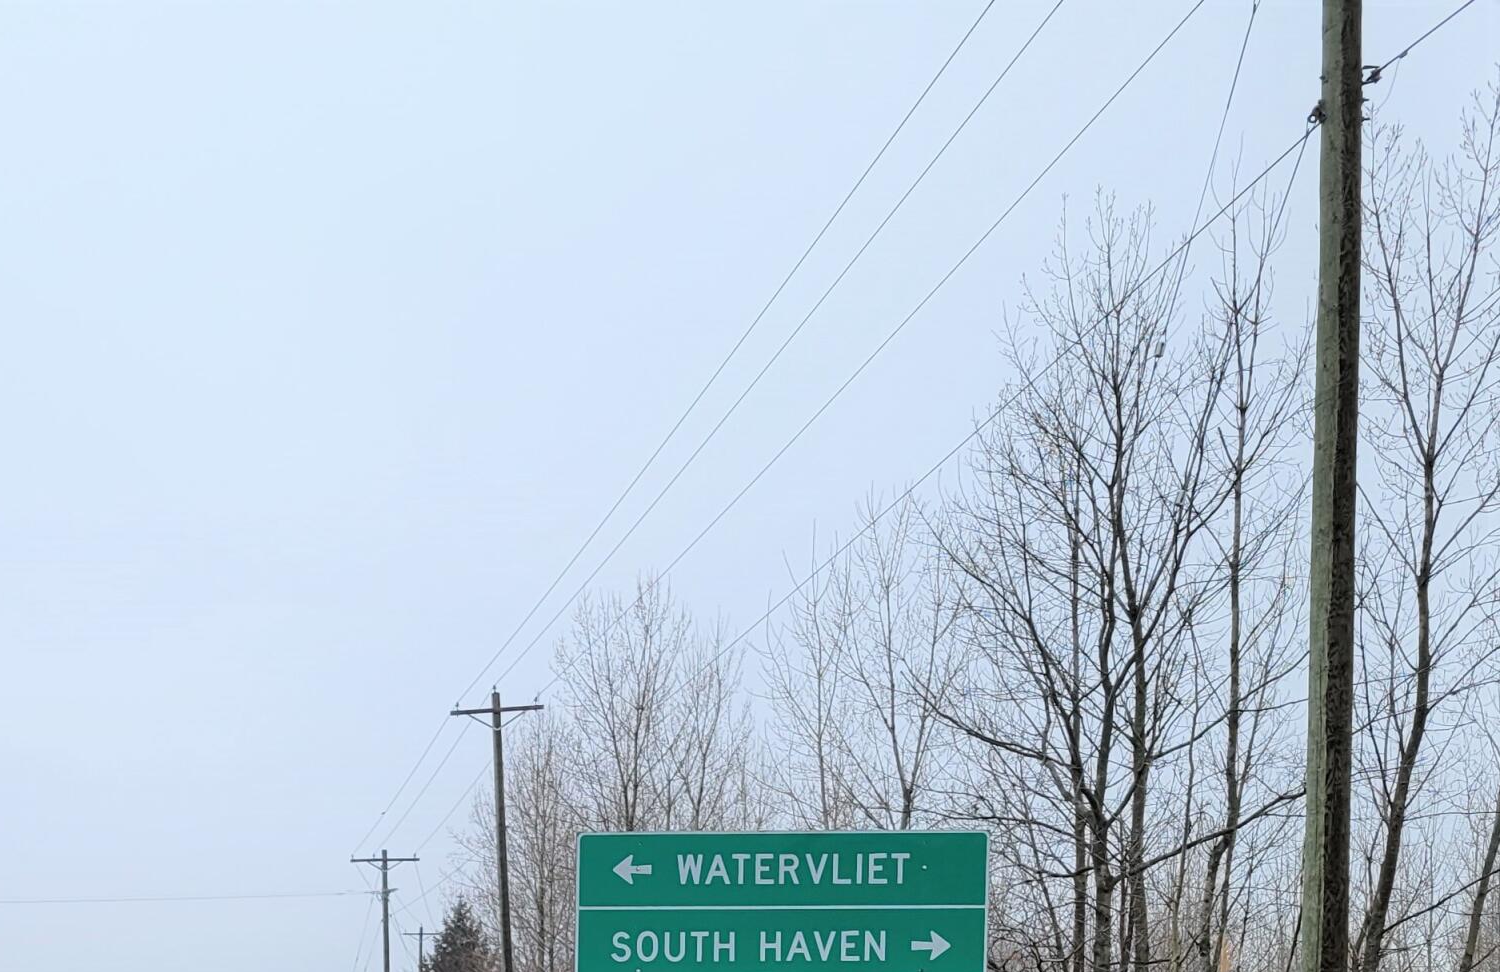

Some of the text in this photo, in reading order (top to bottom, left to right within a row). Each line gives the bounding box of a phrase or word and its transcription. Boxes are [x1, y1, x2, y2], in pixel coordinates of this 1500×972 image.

[676, 852, 911, 885] WATERVLIET
[610, 929, 887, 963] SOUTH HAVEN
